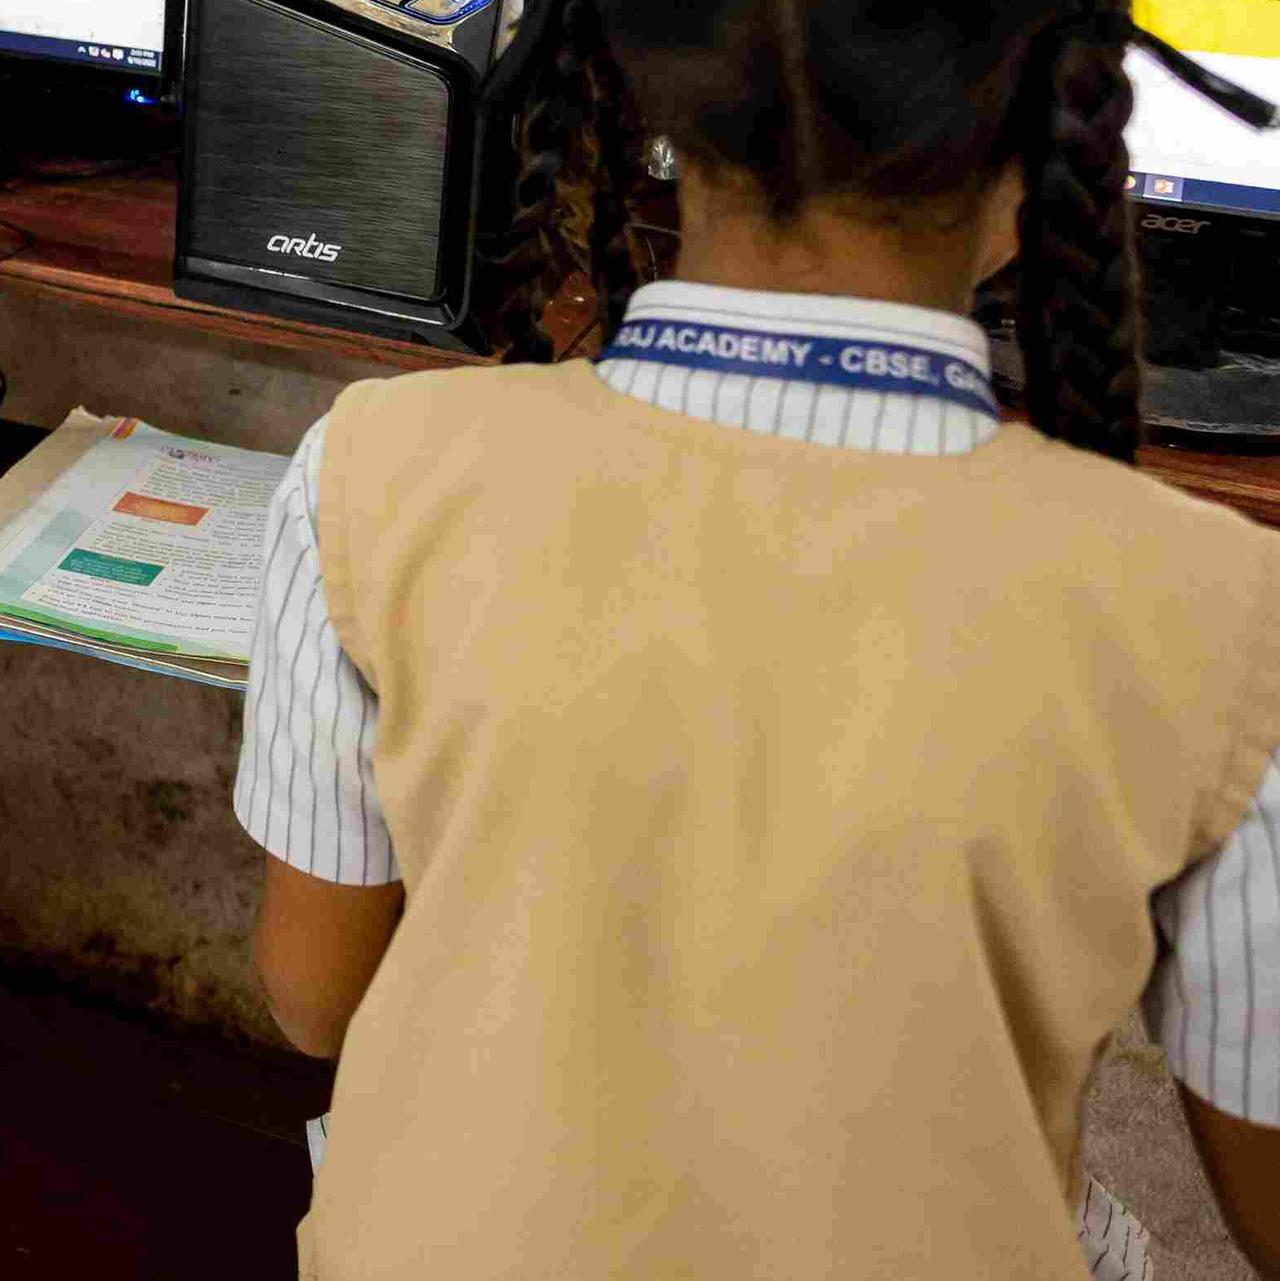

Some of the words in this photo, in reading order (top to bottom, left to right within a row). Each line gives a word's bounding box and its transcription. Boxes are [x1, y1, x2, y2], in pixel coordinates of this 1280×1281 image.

[1140, 213, 1212, 234] acer
[266, 232, 342, 262] artis
[657, 326, 814, 367] ACADEMY
